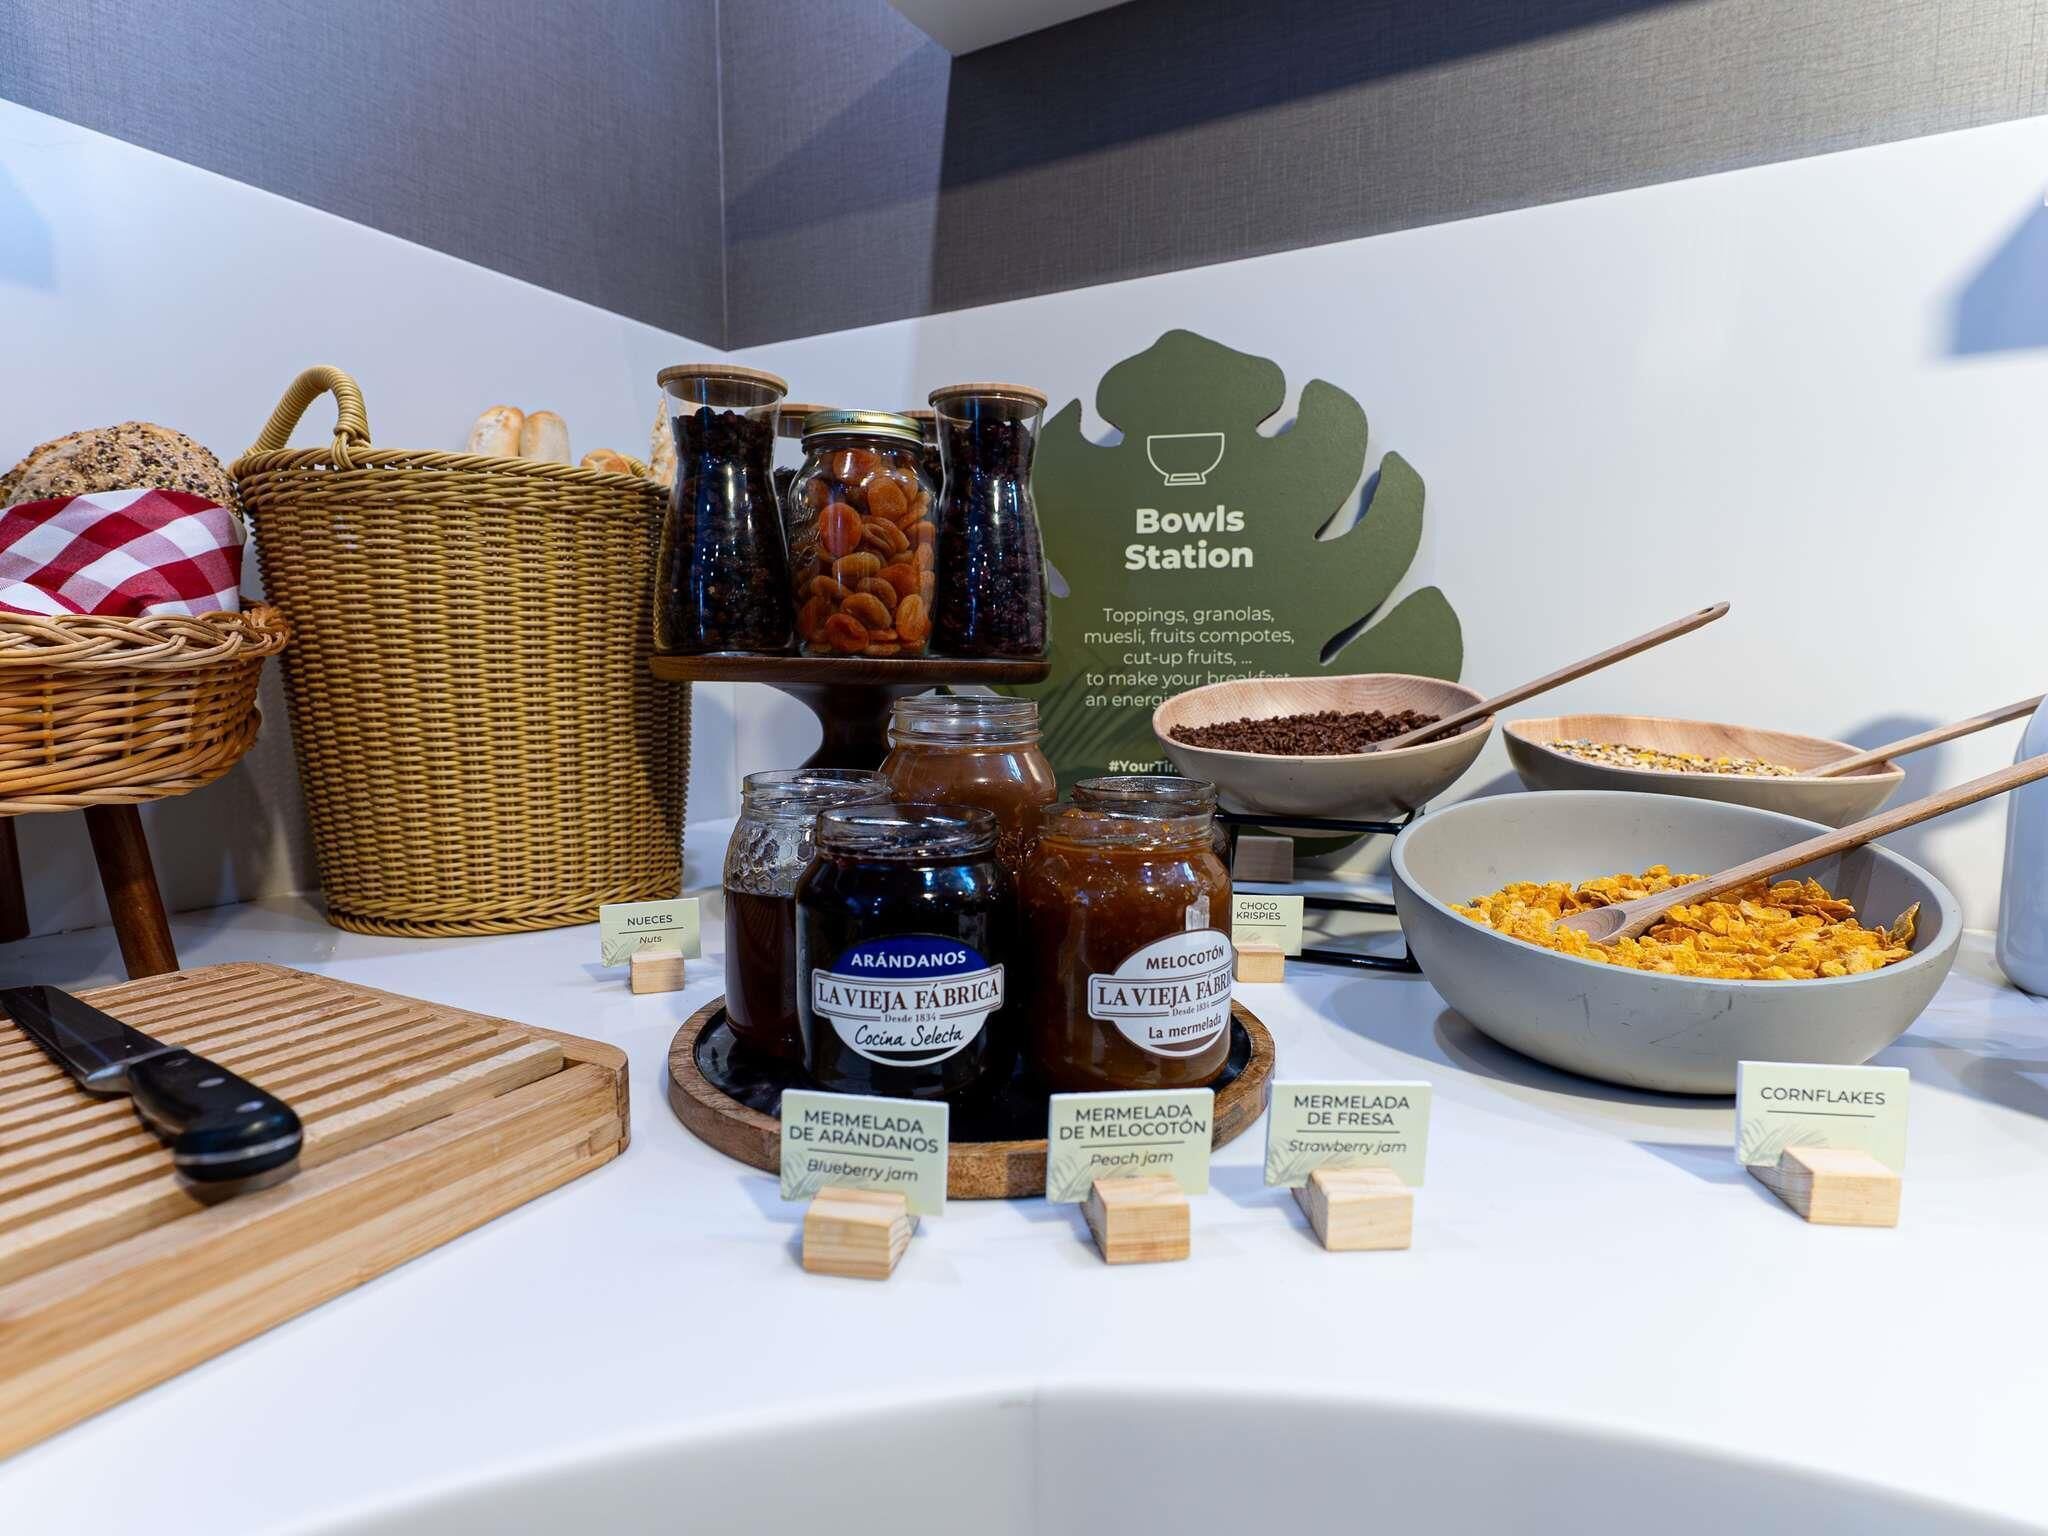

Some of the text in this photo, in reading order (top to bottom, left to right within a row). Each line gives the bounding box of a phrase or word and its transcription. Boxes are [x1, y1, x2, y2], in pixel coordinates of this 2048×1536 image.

[1136, 504, 1245, 534] Bowls
[1125, 539, 1253, 570] Station
[1102, 606, 1275, 625] Toppings, granolas,
[1084, 628, 1295, 645] muesli, fruits compotes,
[1123, 650, 1183, 667] cut-up
[1187, 649, 1237, 666] fruits,
[1086, 672, 1104, 686] to
[1108, 671, 1158, 686] make
[1162, 673, 1201, 689] your
[1085, 691, 1171, 710] an energi
[1236, 911, 1281, 920] KRISPIES
[1240, 902, 1278, 910] CHOCO
[627, 914, 673, 926] NUECES
[639, 936, 662, 944] Nuts
[851, 950, 967, 968] ARÁNDANOS
[1146, 945, 1224, 970] MELOCOTÓN
[818, 978, 1000, 1013] LA VIEJA FÁBRICA
[1098, 986, 1128, 1006] LA
[1131, 985, 1191, 1008] VIEJA
[885, 1012, 936, 1023] Desde 1834
[1172, 1006, 1195, 1017] Desde
[855, 1024, 964, 1046] Cocina Selecta
[1149, 1012, 1222, 1039] La mermelada
[1294, 1095, 1410, 1110] MERMELADA
[1760, 1086, 1886, 1105] CORNFLAKES
[804, 1110, 923, 1134] MERMELADA
[1075, 1104, 1193, 1123] MERMELADA
[1307, 1112, 1394, 1126] DE FRESA
[1060, 1118, 1206, 1140] DE MELOCOTÓN
[789, 1125, 939, 1154] DE ARÁNDANOS
[1288, 1139, 1407, 1155] Strawberry jam
[1090, 1151, 1173, 1167] Peach jam
[807, 1158, 919, 1183] Blueberry jam
